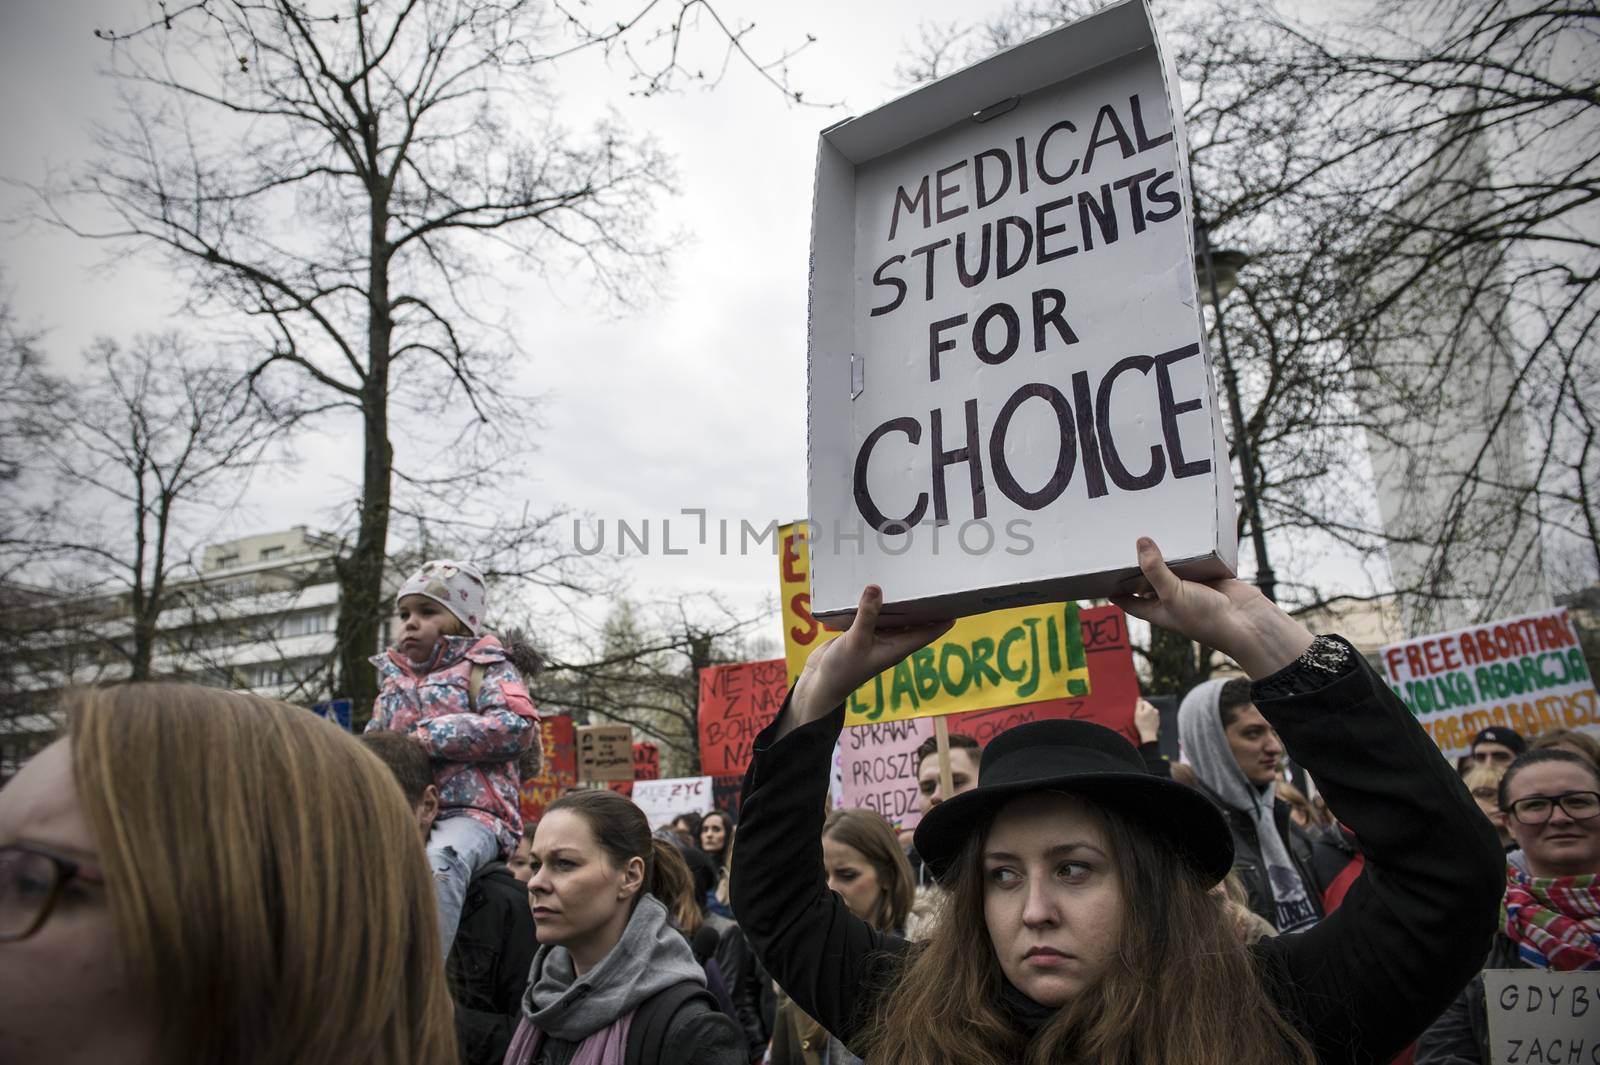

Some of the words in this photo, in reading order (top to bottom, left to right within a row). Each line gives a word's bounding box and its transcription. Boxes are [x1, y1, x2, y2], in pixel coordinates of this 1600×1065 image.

[888, 94, 1173, 242] MEDICAL
[870, 168, 1181, 317] STUDENTS
[929, 289, 1080, 382] FOR
[854, 343, 1211, 536] CHOICE
[891, 601, 1088, 711] ABORCJI!
[1386, 636, 1461, 682] FREE
[1475, 648, 1590, 702] ABORCJA
[702, 667, 745, 702] NIE
[723, 696, 744, 720] Z
[850, 719, 919, 750] SPRAWA
[1500, 985, 1600, 1017] GDYB
